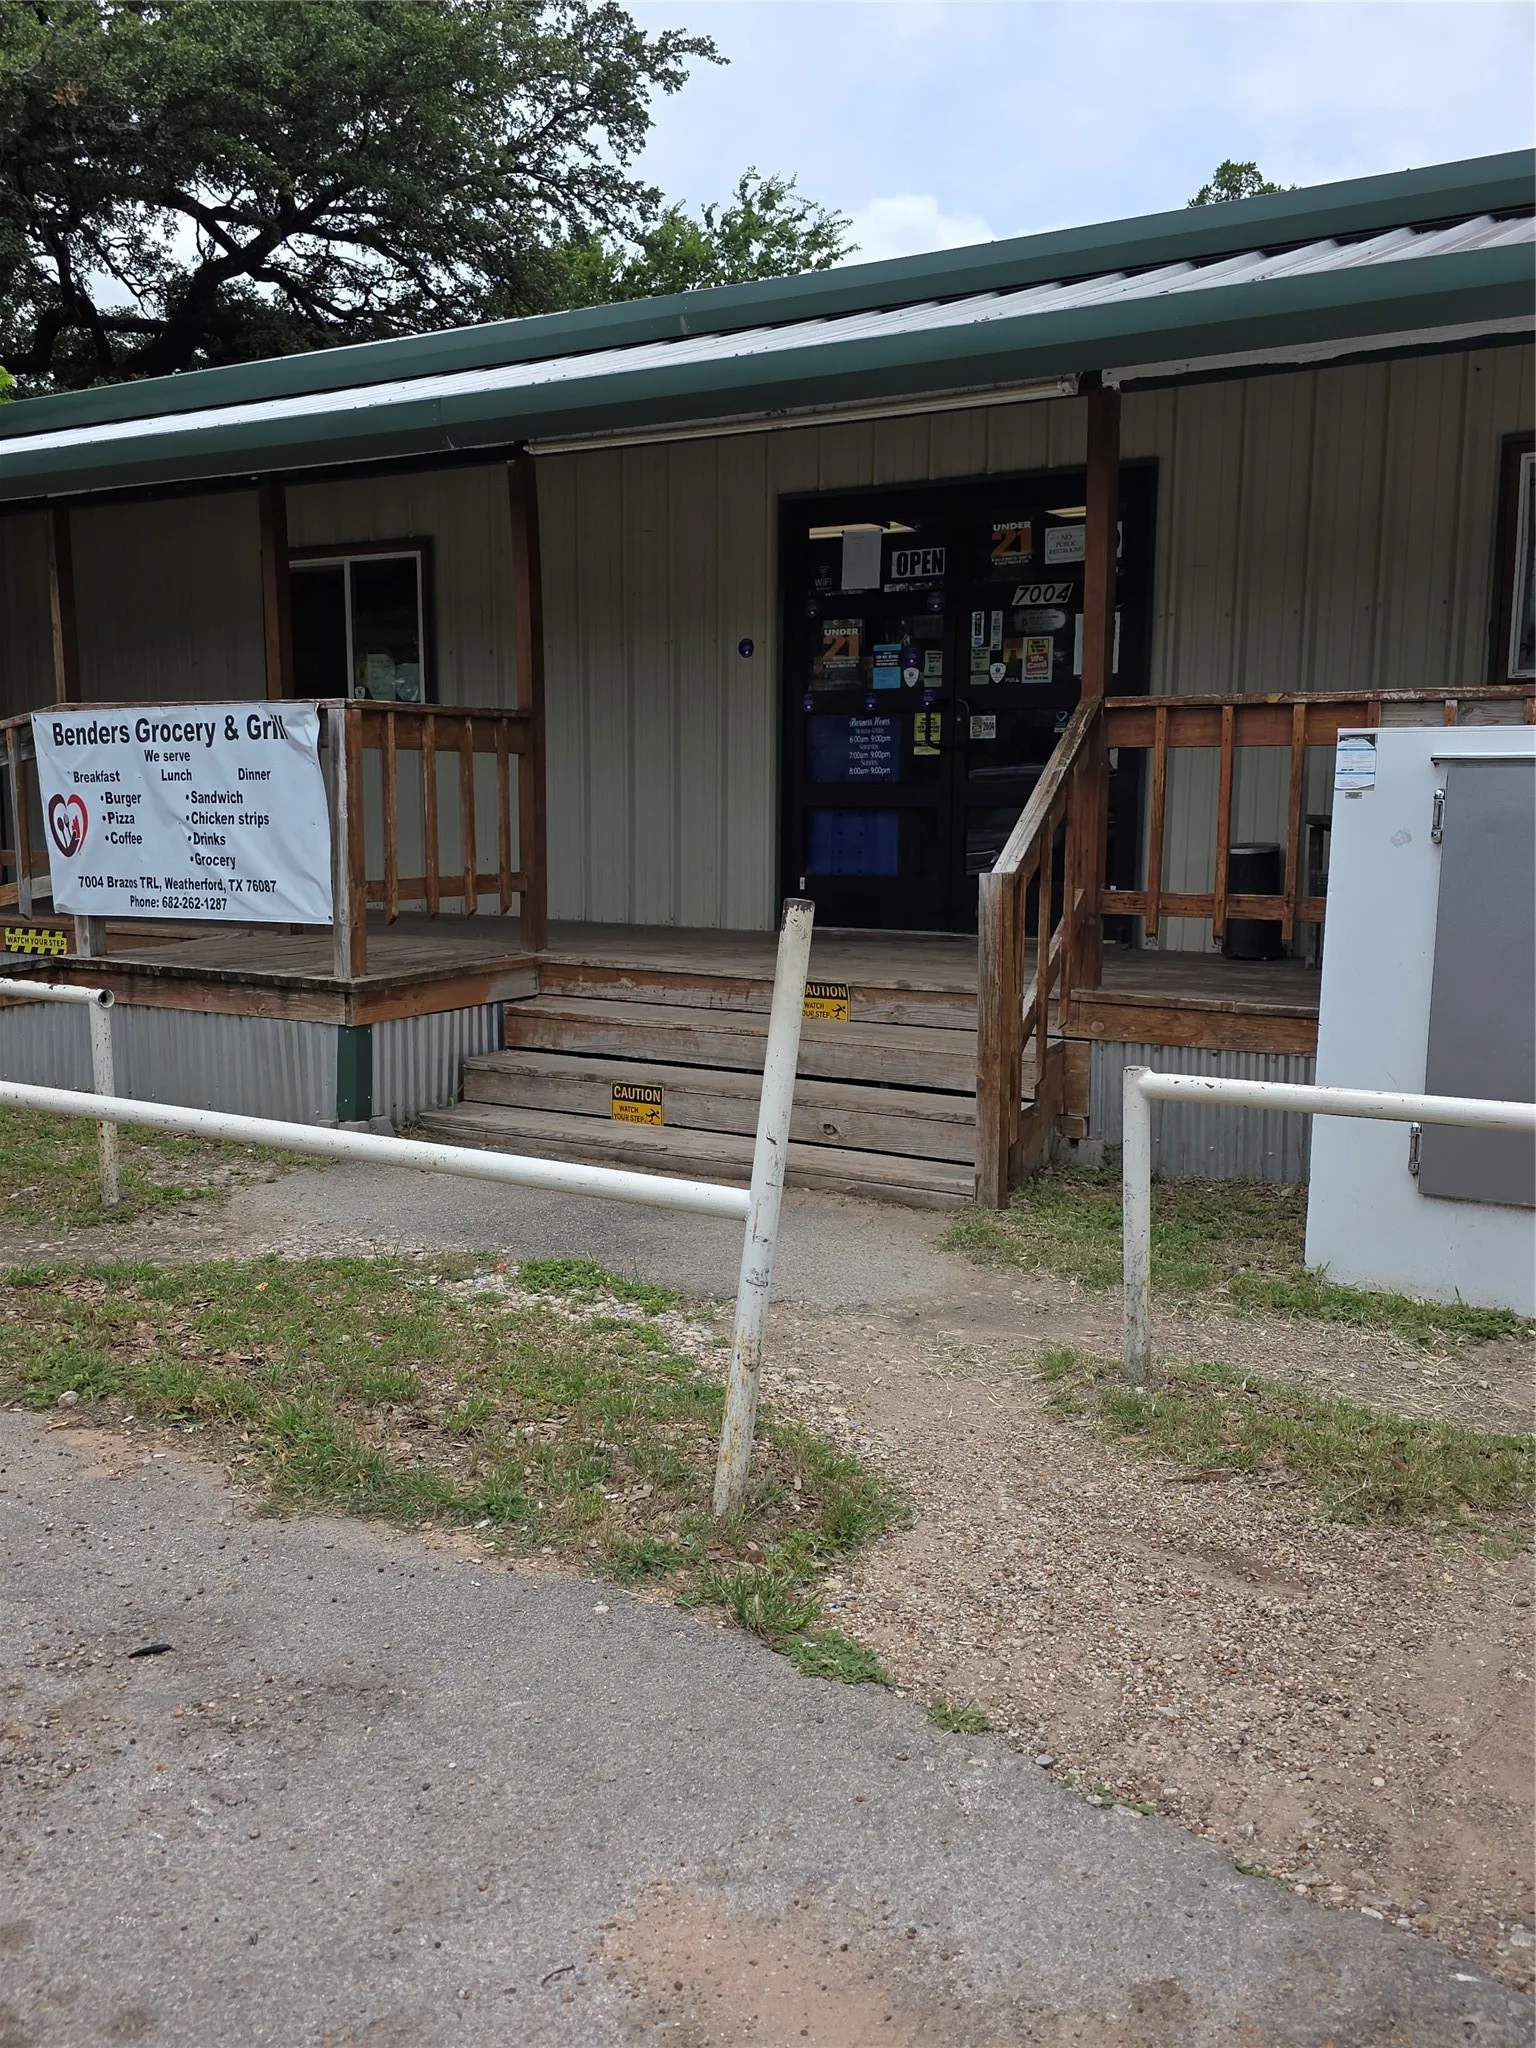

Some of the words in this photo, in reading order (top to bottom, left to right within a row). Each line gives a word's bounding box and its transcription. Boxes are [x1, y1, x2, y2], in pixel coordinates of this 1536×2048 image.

[992, 521, 1032, 531] UNDER
[991, 528, 1033, 558] 21
[896, 550, 944, 576] OPEN
[1015, 584, 1072, 604] 7004
[823, 627, 859, 637] UNDER
[822, 634, 860, 660] 21
[52, 720, 131, 747] Benders
[135, 717, 216, 748] Grocery
[224, 714, 240, 741] &
[144, 749, 160, 762] We
[163, 751, 191, 762] serve
[73, 770, 121, 783] Breakfast
[161, 768, 192, 782] Lunch
[238, 767, 271, 781] Dinner
[238, 811, 270, 829] strips
[77, 875, 104, 888] 7004
[106, 875, 138, 889] Brazos
[139, 876, 162, 892] TRL,
[164, 876, 227, 893] Weatherford,
[228, 878, 243, 892] TX
[246, 880, 277, 893] 76087
[129, 895, 160, 908] Phone:
[162, 895, 228, 911] 682-262-1287
[6, 936, 30, 945] WATCH
[30, 938, 48, 946] YOUR
[48, 939, 65, 948] STEP
[805, 984, 847, 998] AUTION
[803, 1001, 825, 1010] WATCH
[801, 1010, 814, 1018] OUR
[815, 1010, 831, 1018] STEP
[613, 1085, 661, 1103] CAUTION
[618, 1105, 639, 1114] WATCH
[613, 1113, 629, 1121] YOUR
